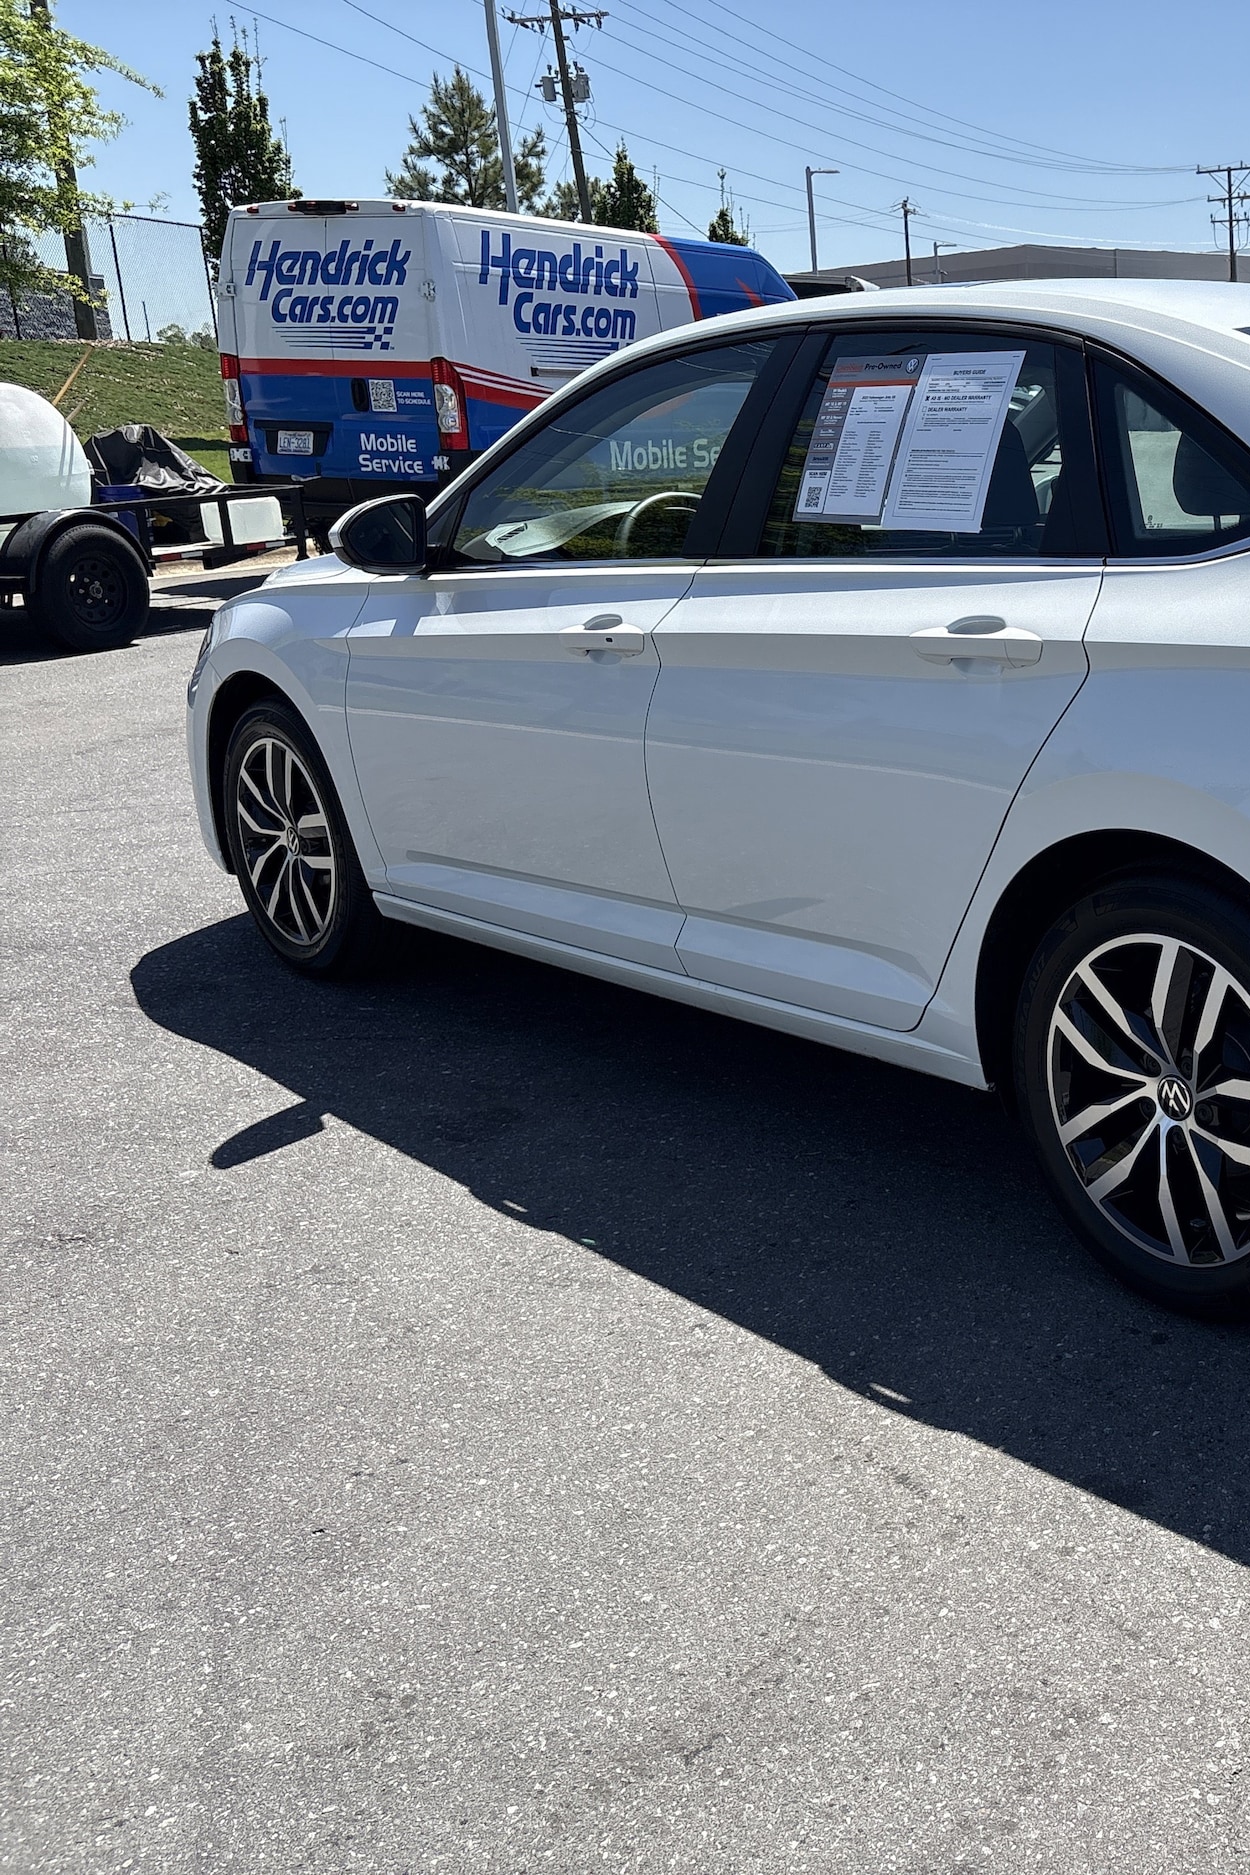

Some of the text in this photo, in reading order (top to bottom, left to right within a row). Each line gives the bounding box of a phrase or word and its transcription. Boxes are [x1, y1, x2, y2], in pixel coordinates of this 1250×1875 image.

[244, 240, 412, 301] Hendrick
[478, 230, 638, 305] Hendrick
[271, 288, 399, 324] Cars.com
[513, 292, 636, 340] Cars.com
[864, 361, 902, 370] Pre-Owned
[360, 433, 417, 453] Mobile
[609, 439, 687, 471] Mobile
[358, 454, 424, 474] Service
